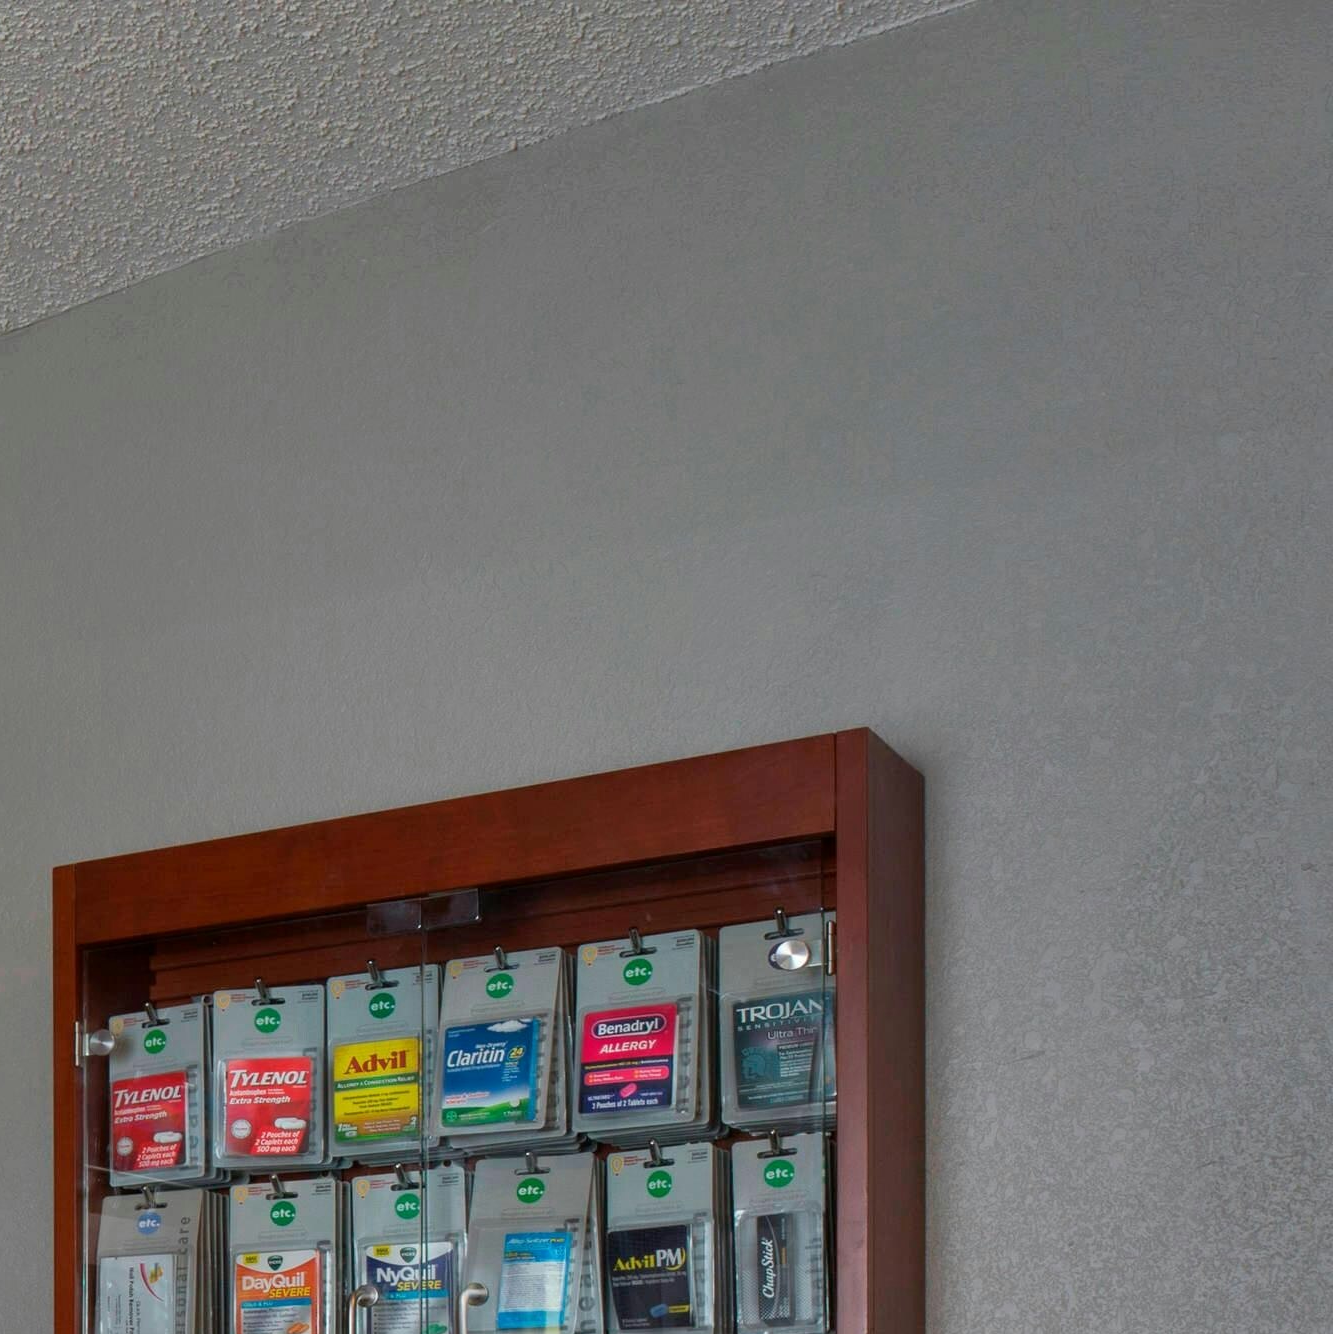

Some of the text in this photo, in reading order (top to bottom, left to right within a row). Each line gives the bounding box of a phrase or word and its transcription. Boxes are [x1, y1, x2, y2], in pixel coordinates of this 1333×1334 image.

[736, 999, 823, 1023] TROJAN
[255, 1016, 281, 1026] etc.
[597, 1017, 659, 1036] Benadryl
[767, 1028, 794, 1040] Ultra
[600, 1039, 657, 1054] ALLERGY
[343, 1050, 408, 1075] Advil
[447, 1047, 506, 1068] Claritin
[230, 1070, 309, 1088] TYLENOL
[114, 1086, 183, 1108] TYLENOL
[230, 1096, 291, 1105] Extra Strength
[765, 1168, 795, 1180] etc.
[613, 1248, 682, 1272] Advil PM
[760, 1237, 776, 1299] ChapStick
[241, 1272, 307, 1291] DayQuil
[375, 1267, 438, 1290] NyQuil
[396, 1278, 443, 1292] SEVERE
[269, 1285, 312, 1298] SEVERE
